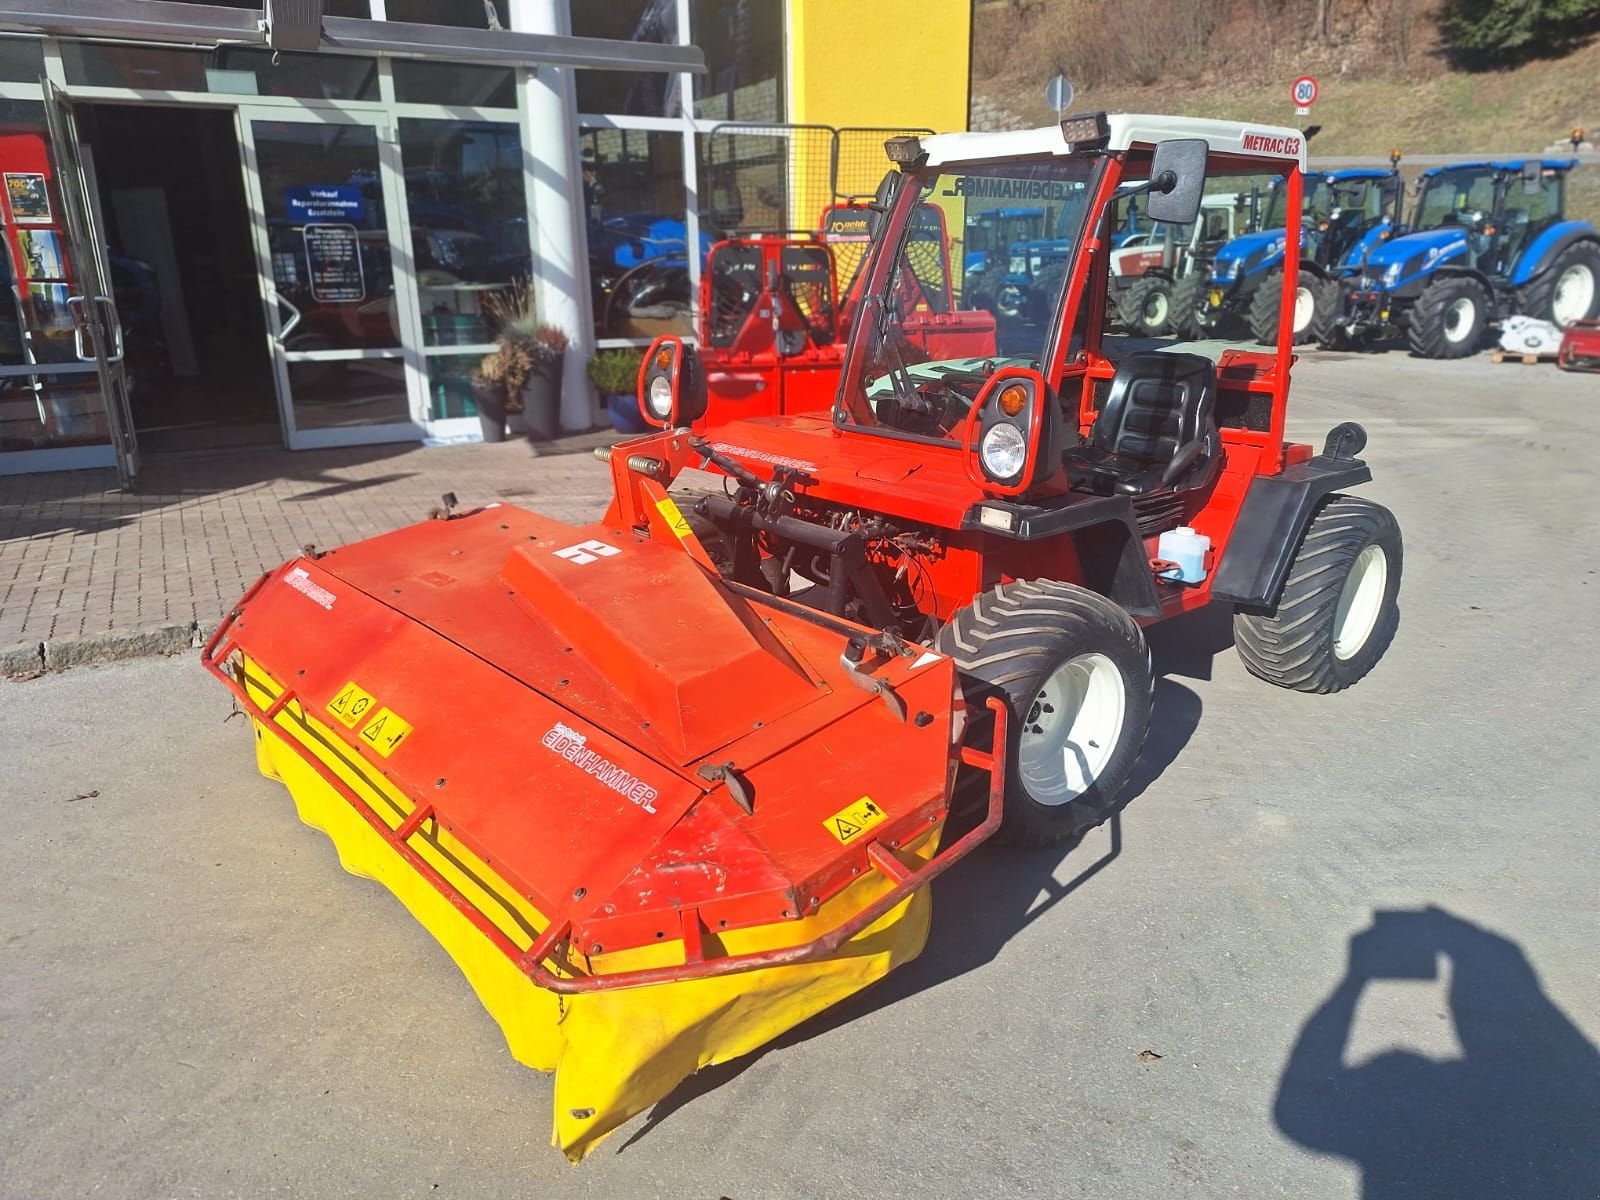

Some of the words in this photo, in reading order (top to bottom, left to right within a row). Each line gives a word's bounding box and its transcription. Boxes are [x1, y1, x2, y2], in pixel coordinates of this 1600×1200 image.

[1297, 83, 1313, 100] 80
[1243, 134, 1283, 153] METRAC
[1283, 136, 1300, 155] G3
[541, 728, 658, 812] EIDENHAMMER
